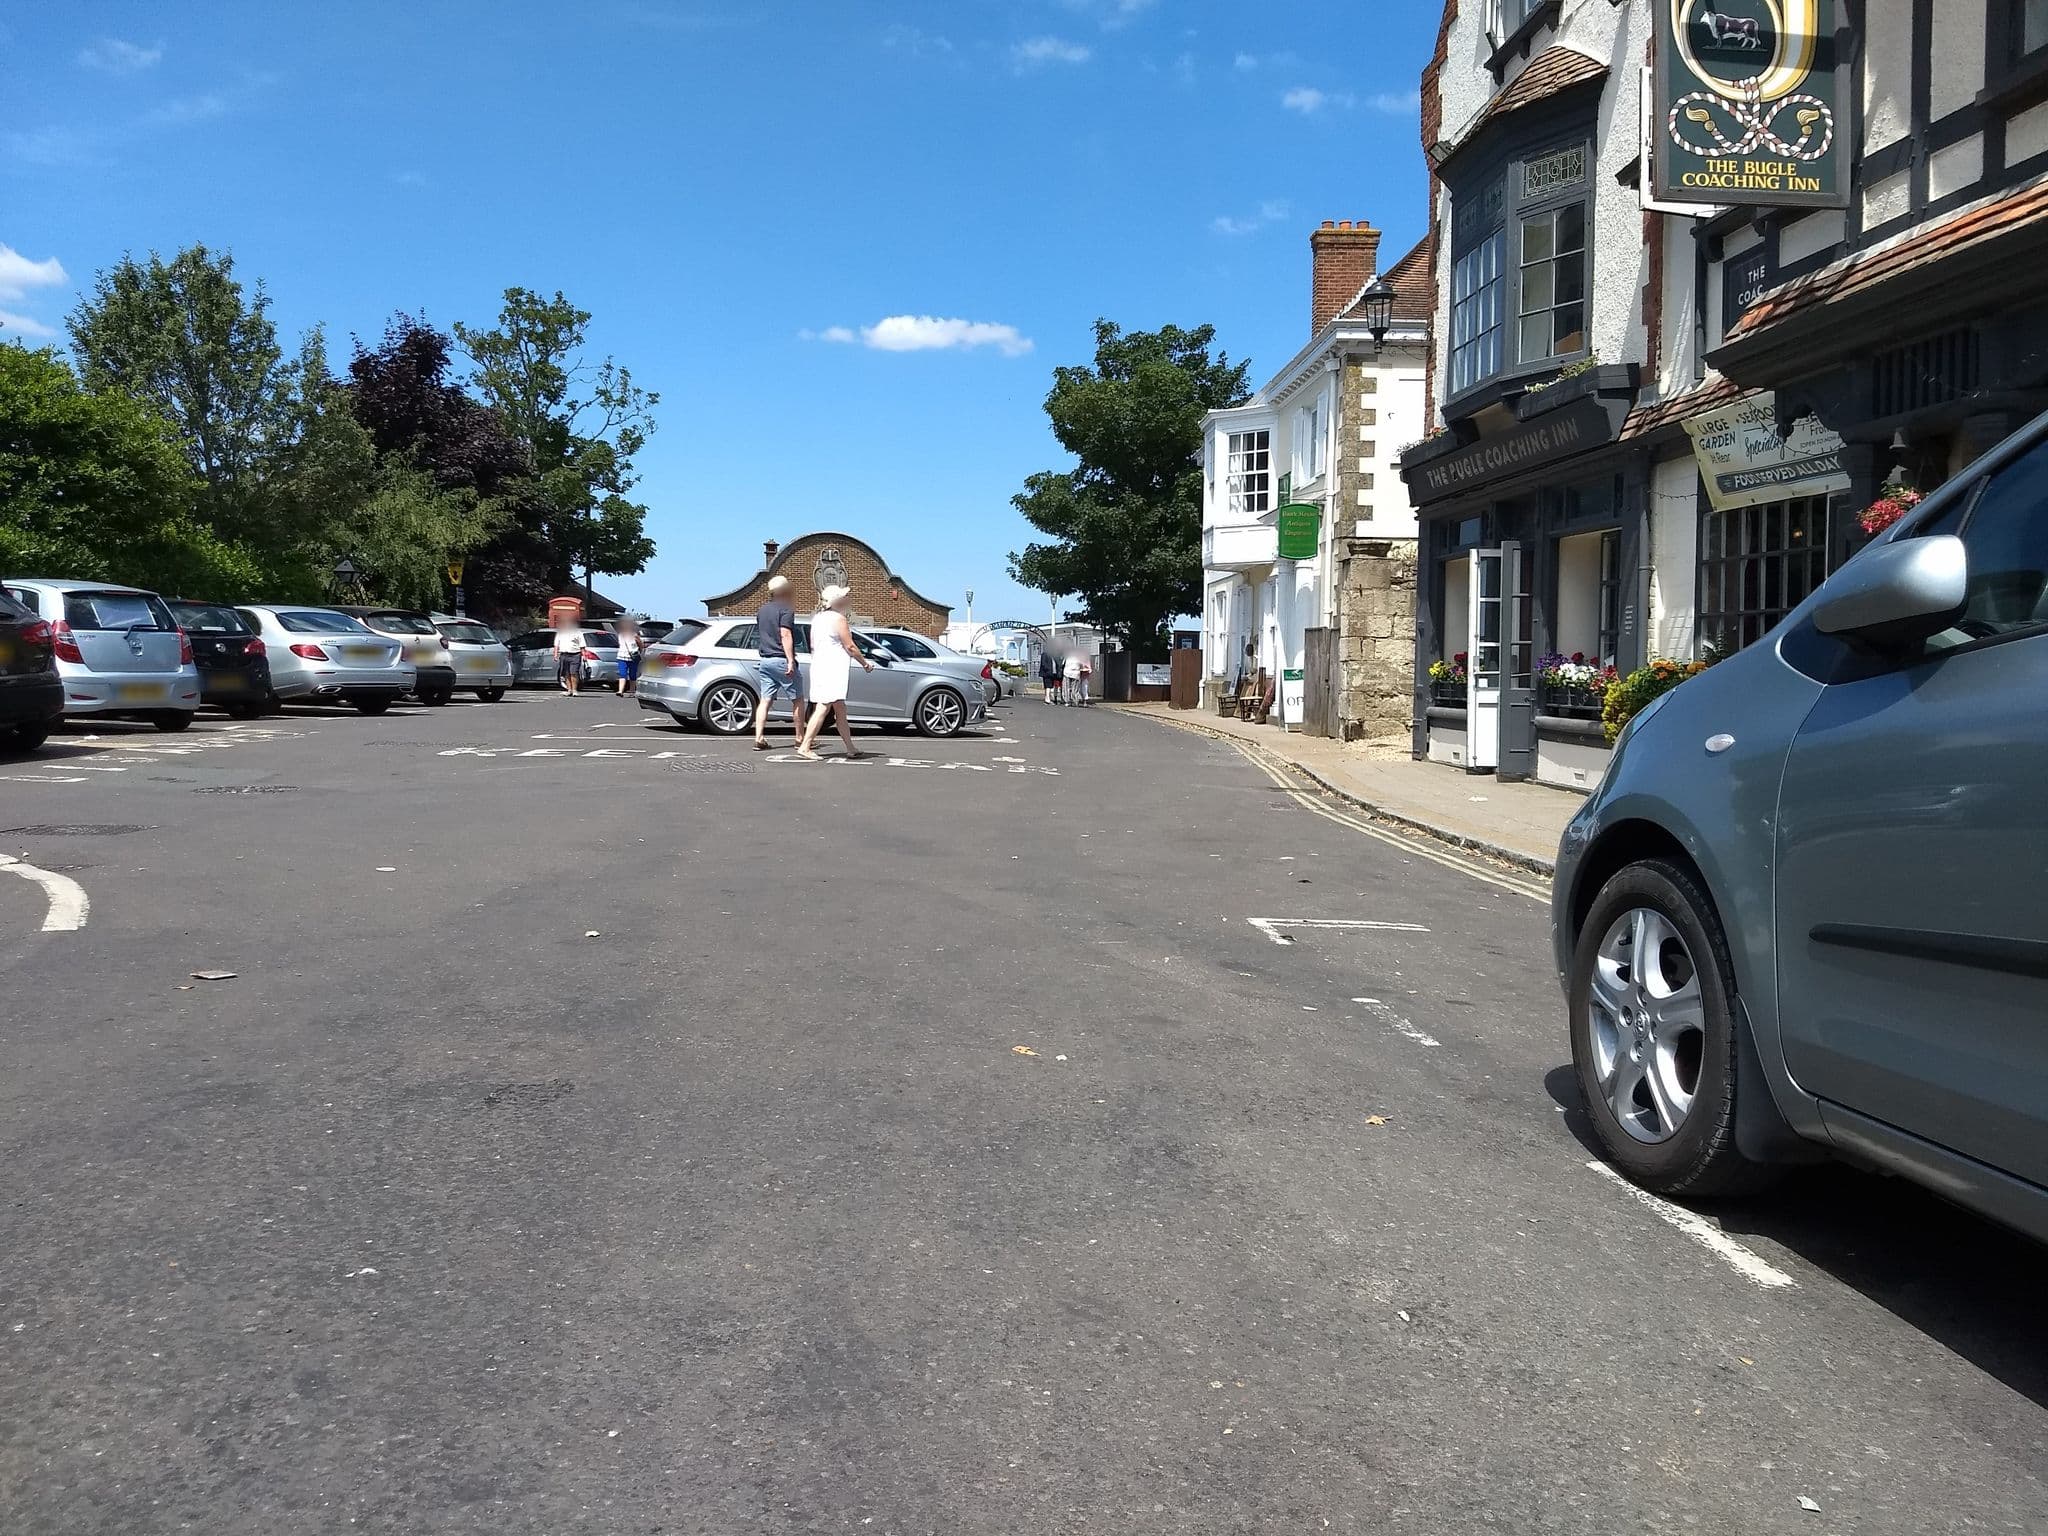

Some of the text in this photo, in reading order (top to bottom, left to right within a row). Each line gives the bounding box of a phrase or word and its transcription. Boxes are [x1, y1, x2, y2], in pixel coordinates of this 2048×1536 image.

[1706, 160, 1797, 176] THE BUGLE
[1682, 173, 1820, 191] COACHING INN
[1748, 265, 1765, 283] THE
[1699, 431, 1736, 450] GARDEN
[1427, 465, 1449, 489] THE
[1486, 429, 1550, 469] COACHING
[1552, 417, 1580, 447] INN
[1799, 462, 1817, 477] ALL
[1815, 455, 1842, 472] DAY
